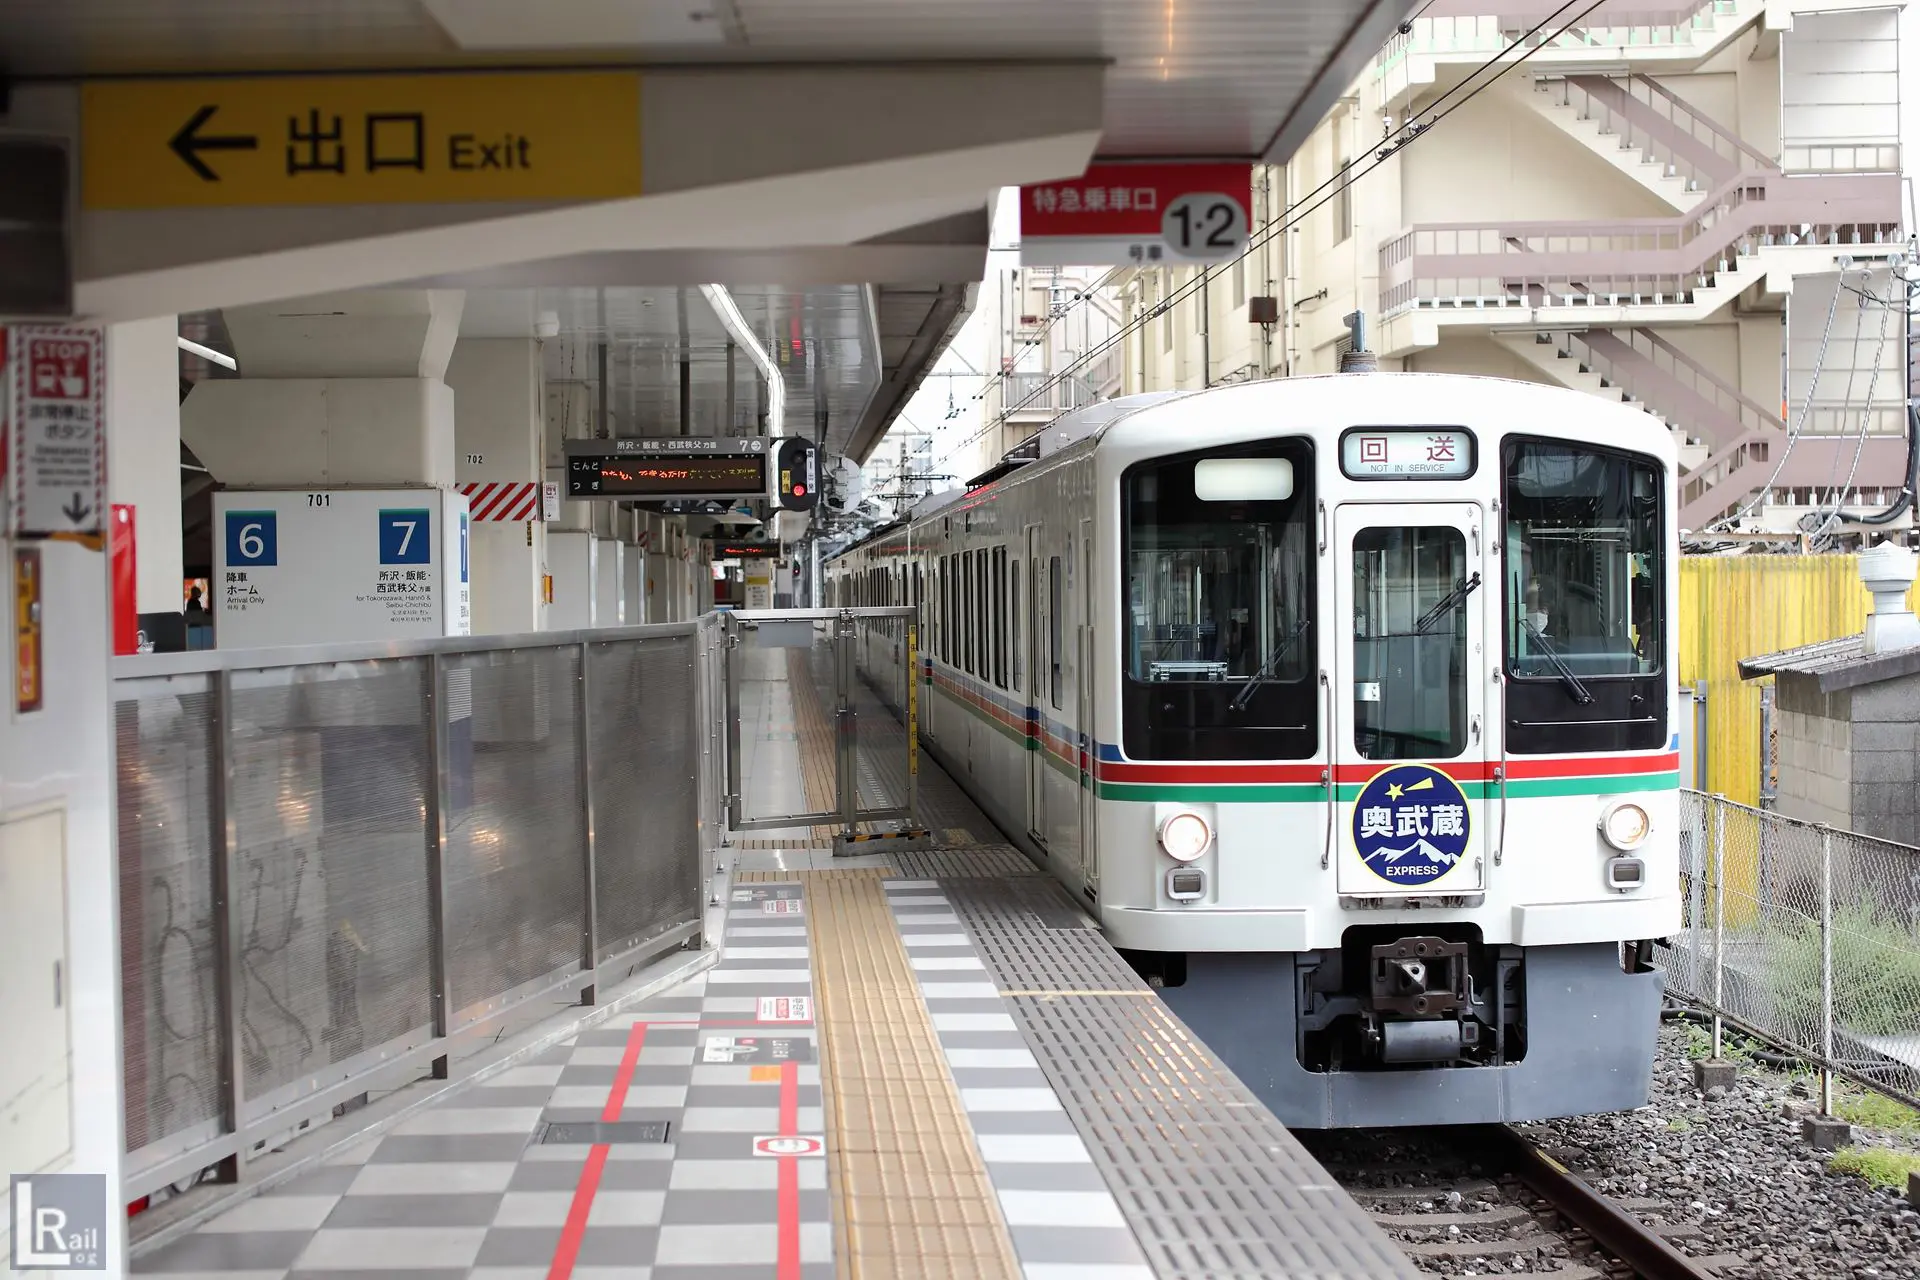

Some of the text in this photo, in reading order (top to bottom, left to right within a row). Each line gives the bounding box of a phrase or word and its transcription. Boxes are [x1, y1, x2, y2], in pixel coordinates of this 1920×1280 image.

[286, 108, 426, 177] 出口
[448, 135, 531, 170] Exit
[1032, 187, 1157, 213] 特急乗車口
[34, 343, 87, 360] STOP
[739, 440, 748, 451] 7
[1360, 436, 1456, 463] 回送
[467, 455, 483, 464] 702
[573, 462, 599, 471] こんど
[1370, 463, 1445, 473] NOT IN SERVICE
[307, 494, 331, 507] 701
[238, 523, 264, 558] 6
[392, 521, 417, 556] 7
[226, 572, 248, 583] 降車
[227, 585, 258, 595] ホーム
[227, 596, 265, 605] Arrival Only
[1360, 804, 1464, 839] 奥武蔵
[1386, 865, 1439, 876] EXPRESS
